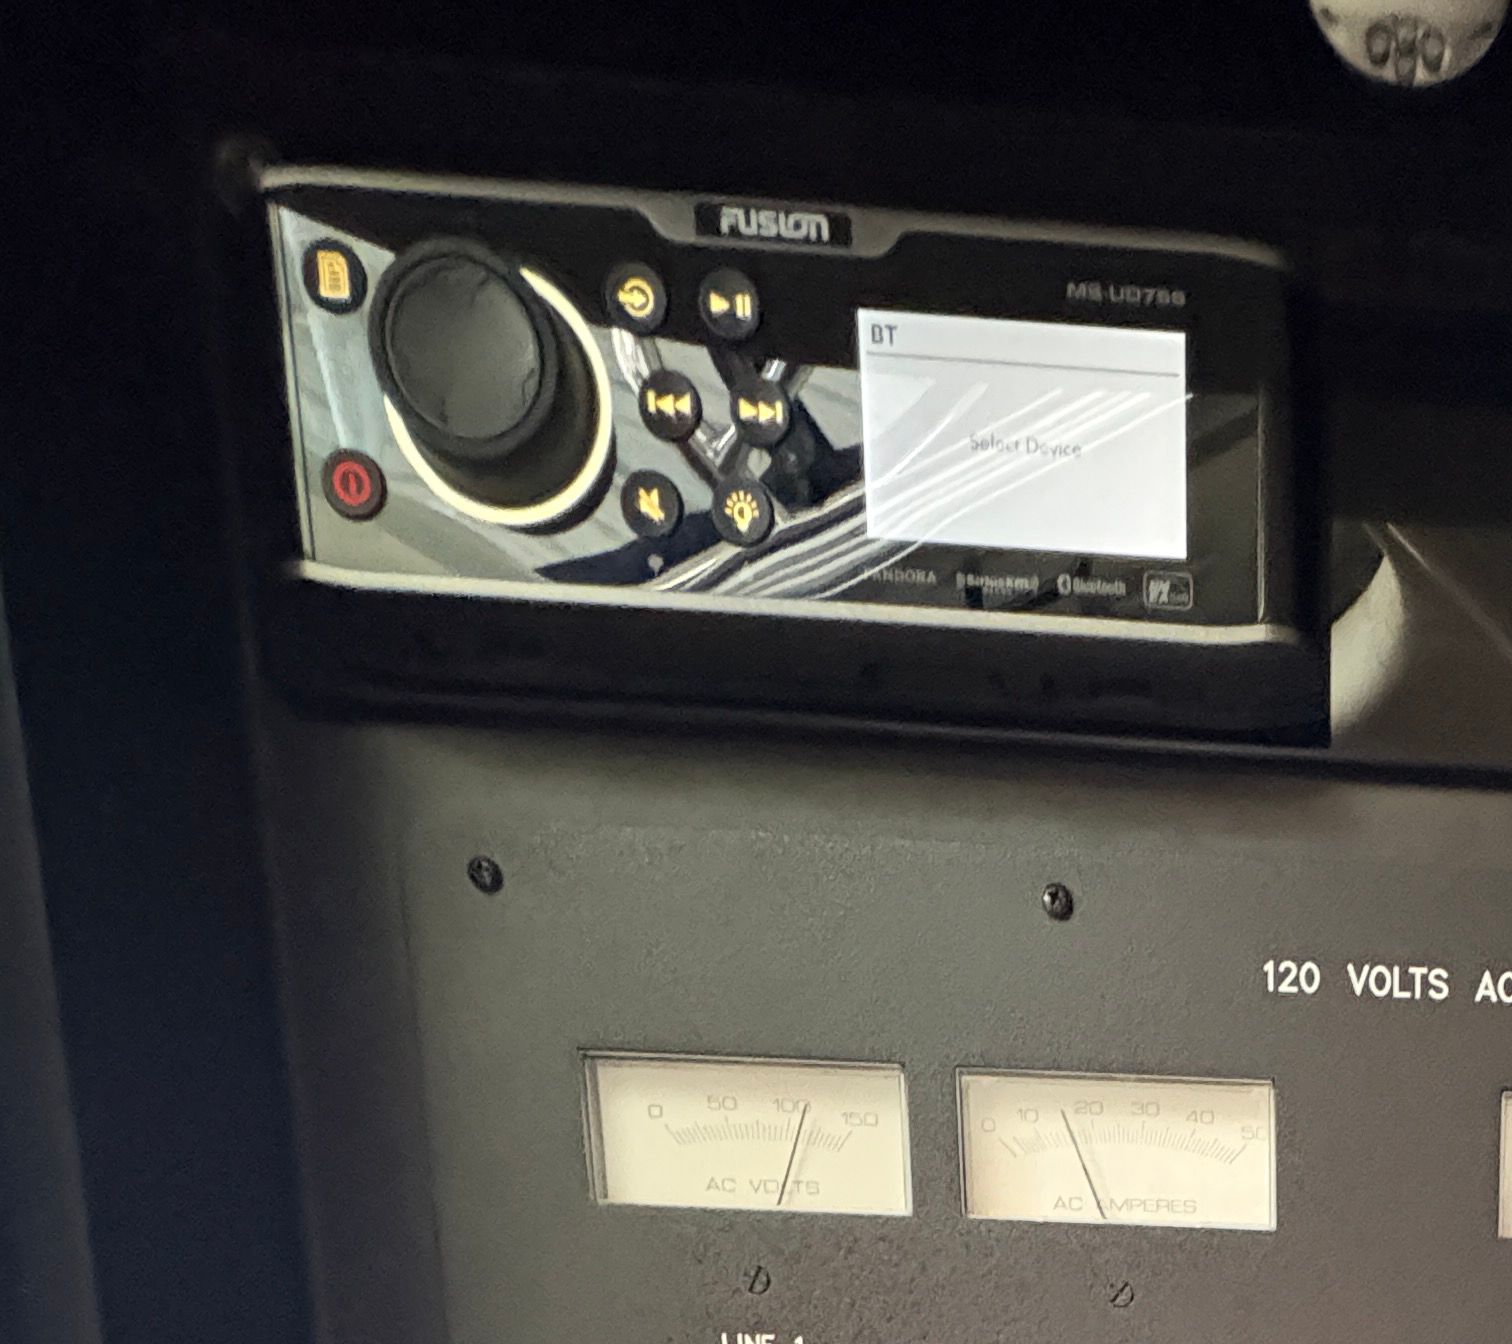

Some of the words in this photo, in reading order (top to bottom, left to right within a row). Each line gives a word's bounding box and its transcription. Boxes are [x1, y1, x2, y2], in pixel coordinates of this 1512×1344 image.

[871, 324, 898, 345] BT
[1026, 435, 1082, 457] Device
[1263, 960, 1320, 994] 120
[1347, 963, 1449, 1000] VOLTS
[707, 1096, 738, 1111] 50
[842, 1112, 878, 1127] 150
